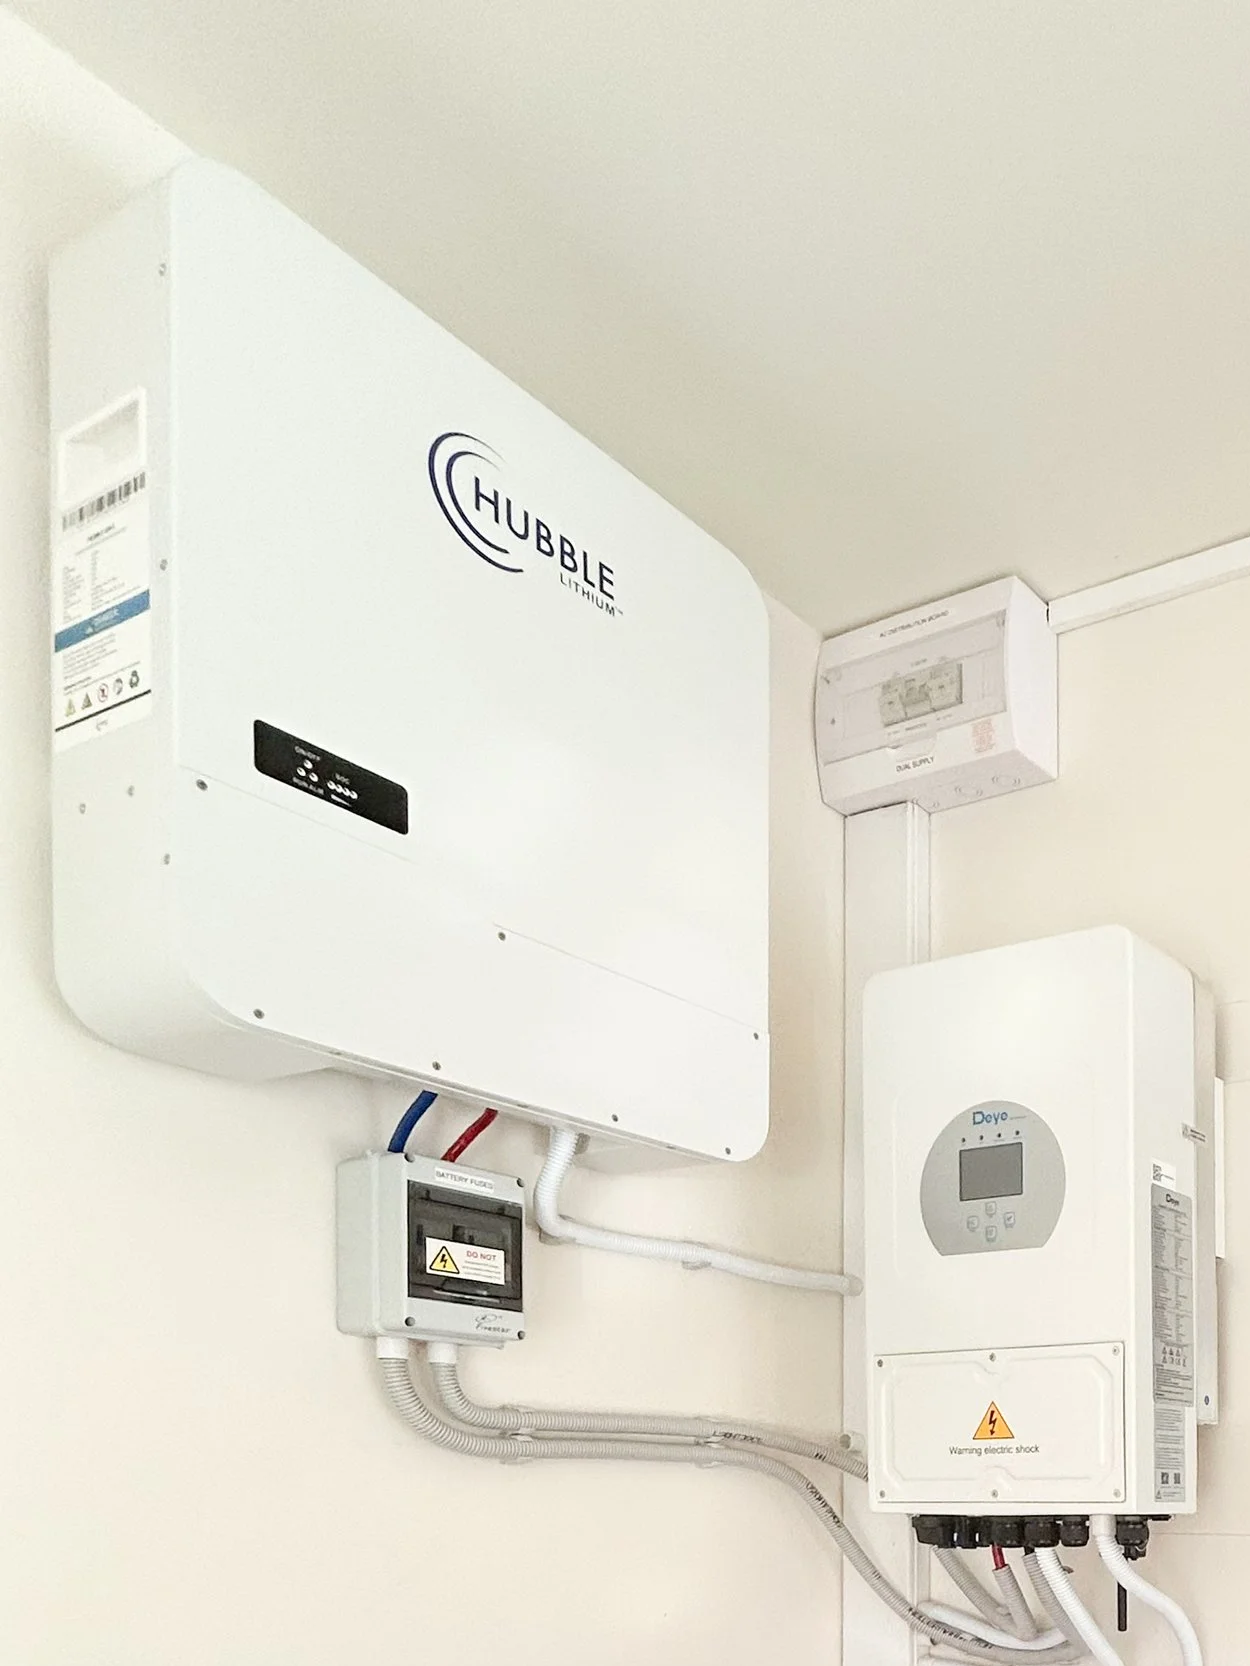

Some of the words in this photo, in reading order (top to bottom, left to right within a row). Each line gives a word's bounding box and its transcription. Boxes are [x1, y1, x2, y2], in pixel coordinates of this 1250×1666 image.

[474, 475, 615, 601] HUBBLE
[911, 755, 934, 769] SUPPLY
[972, 1110, 1009, 1126] Deye
[435, 1170, 469, 1184] BATTERY
[470, 1178, 494, 1190] FUSES
[466, 1250, 479, 1259] DO
[480, 1253, 497, 1261] NOT
[949, 1445, 982, 1457] Warning
[984, 1445, 1014, 1455] electric
[1015, 1443, 1040, 1454] shock
